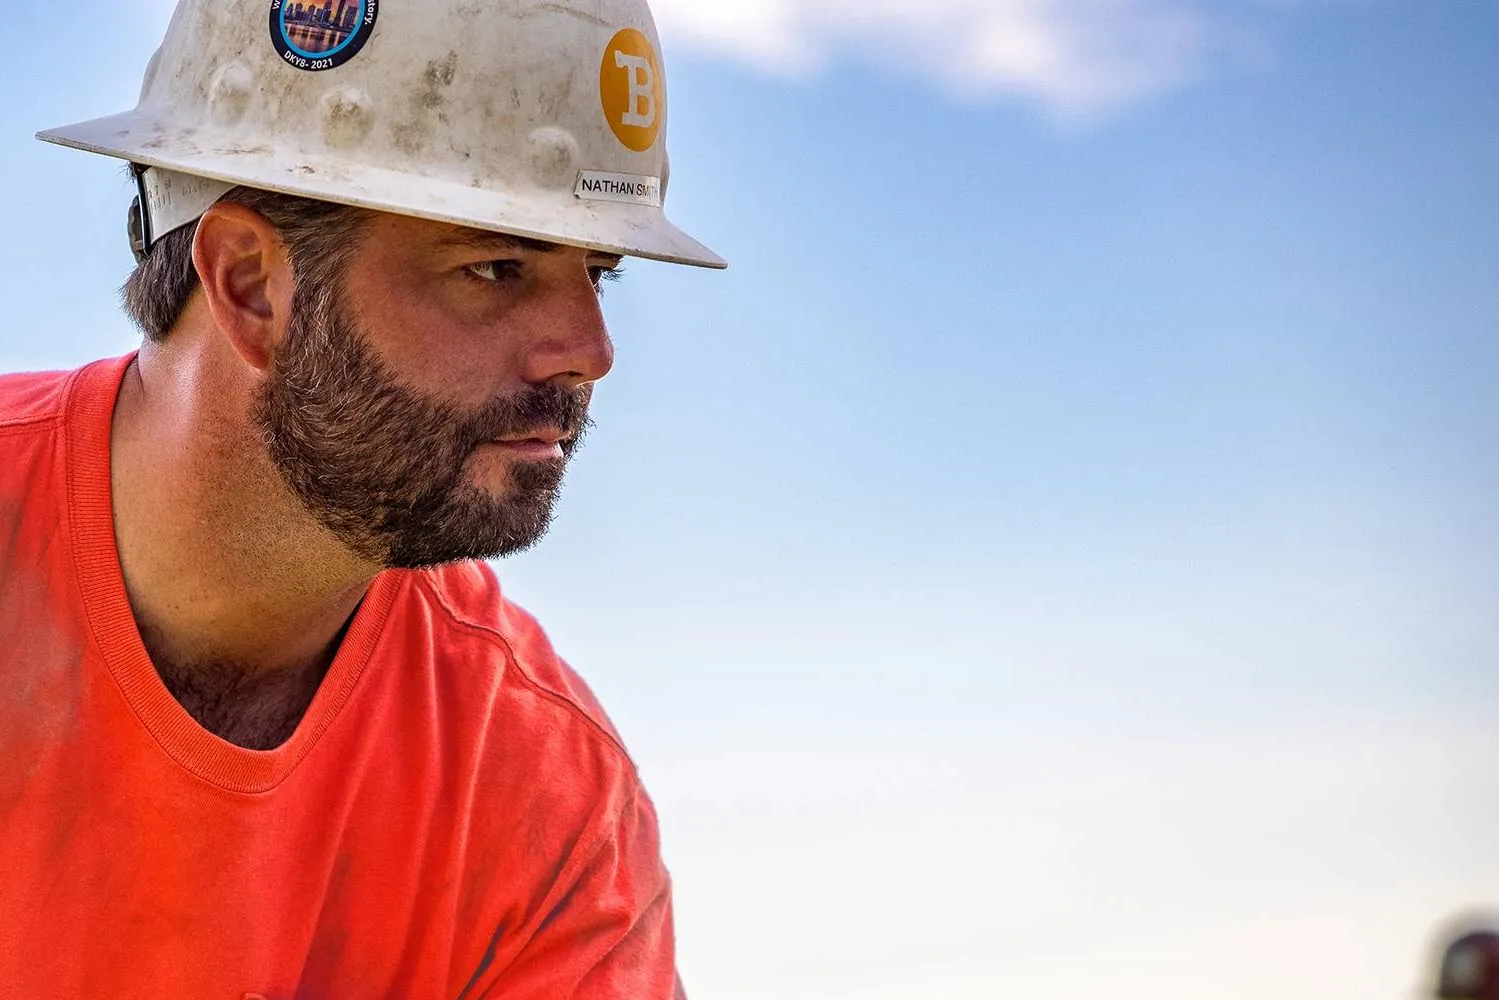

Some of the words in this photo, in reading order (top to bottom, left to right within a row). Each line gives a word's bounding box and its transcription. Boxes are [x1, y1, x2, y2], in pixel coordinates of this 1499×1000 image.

[310, 58, 333, 69] 2021
[614, 49, 656, 128] B
[582, 179, 635, 195] NATHAN
